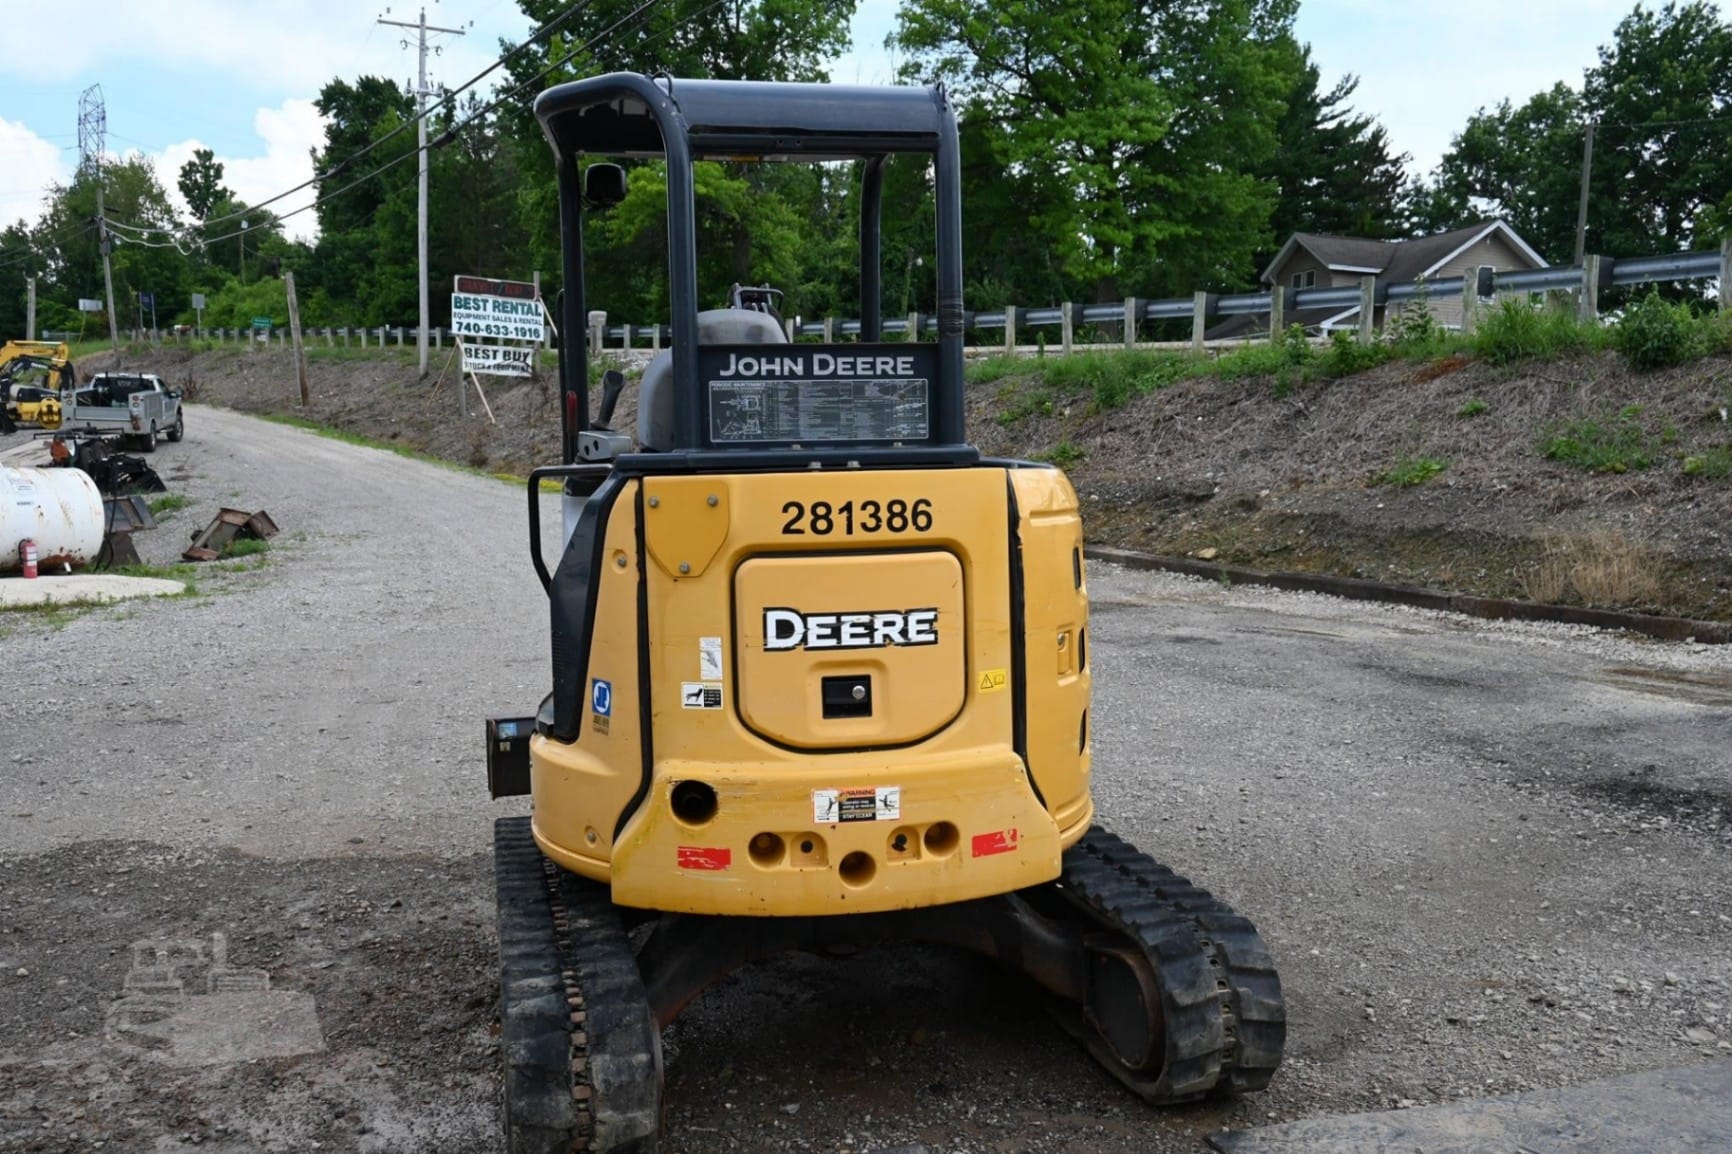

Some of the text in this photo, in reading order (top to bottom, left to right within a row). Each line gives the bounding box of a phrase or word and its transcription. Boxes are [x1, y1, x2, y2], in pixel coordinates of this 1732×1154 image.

[454, 297, 542, 317] BEST RENTAL
[453, 312, 490, 321] EQUIPMENT
[492, 315, 512, 324] SALES
[519, 318, 543, 326] RENTAL
[456, 322, 540, 338] 740-633-1916
[464, 347, 530, 363] BEST BUY
[719, 353, 914, 376] JOHN DEERE
[781, 498, 933, 536] 281386
[765, 609, 937, 650] DEERE
